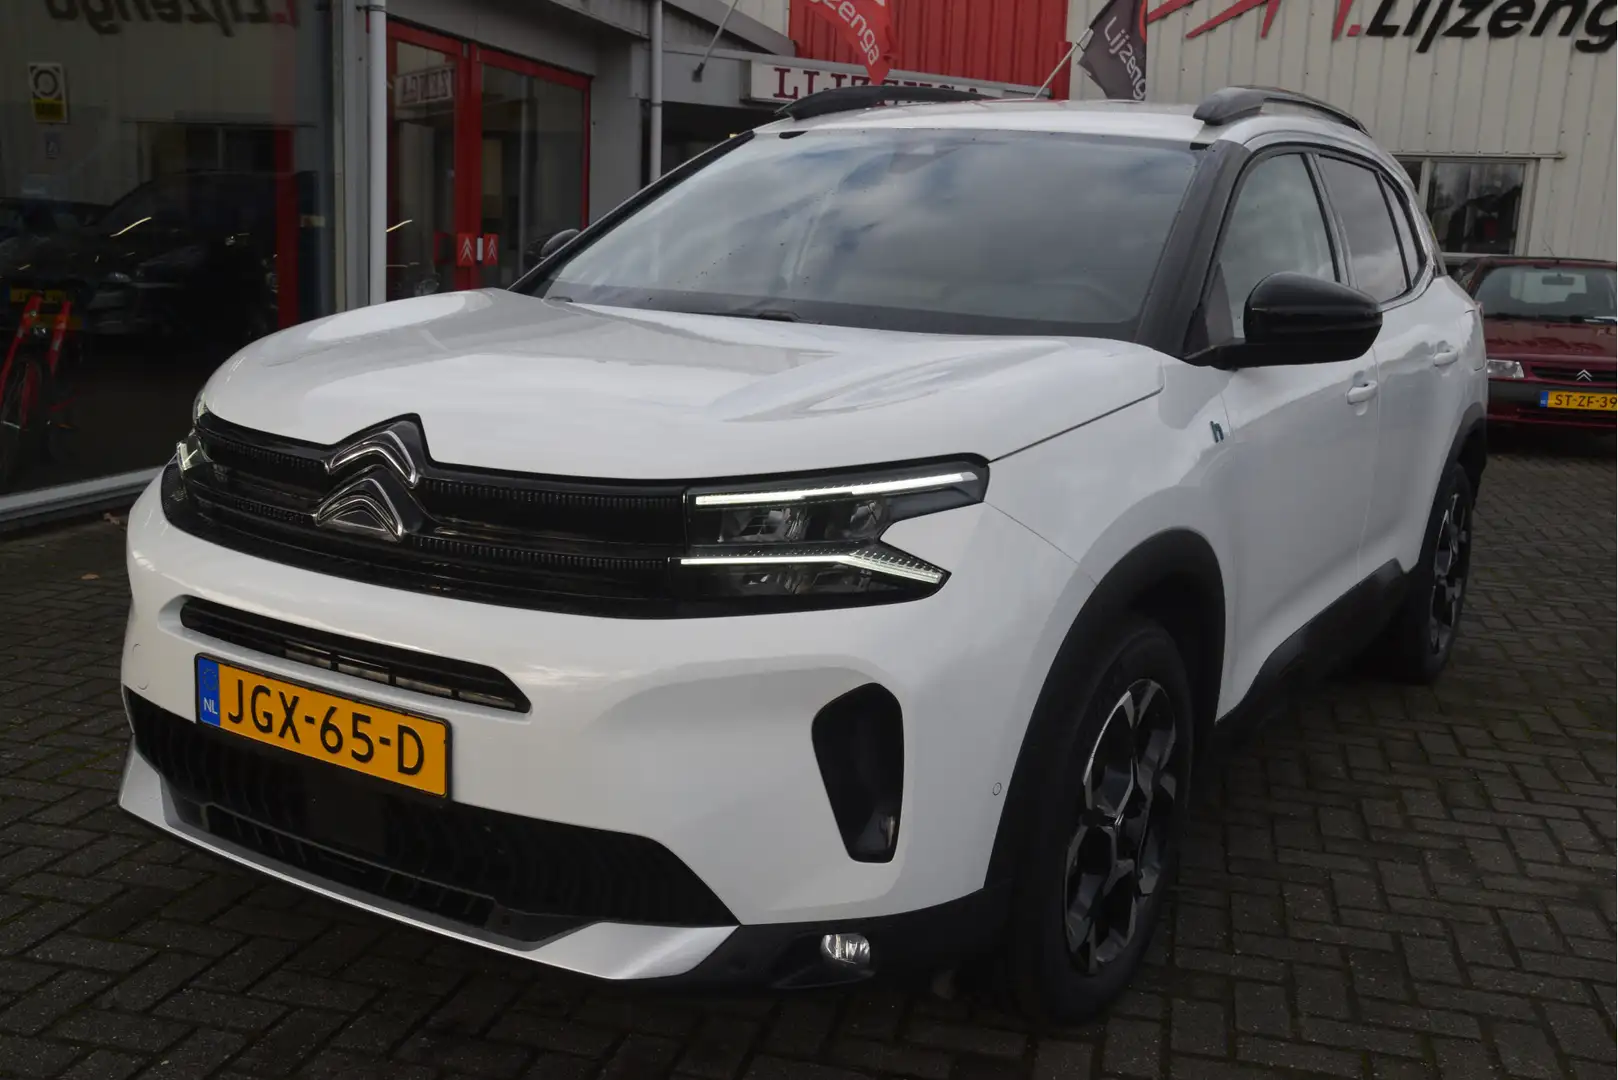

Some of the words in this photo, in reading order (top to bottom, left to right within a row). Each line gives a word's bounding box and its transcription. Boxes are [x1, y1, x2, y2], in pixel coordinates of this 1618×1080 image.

[1554, 394, 1616, 409] ST-ZF-39
[203, 696, 219, 716] NL
[228, 679, 424, 776] JGX-65-D
